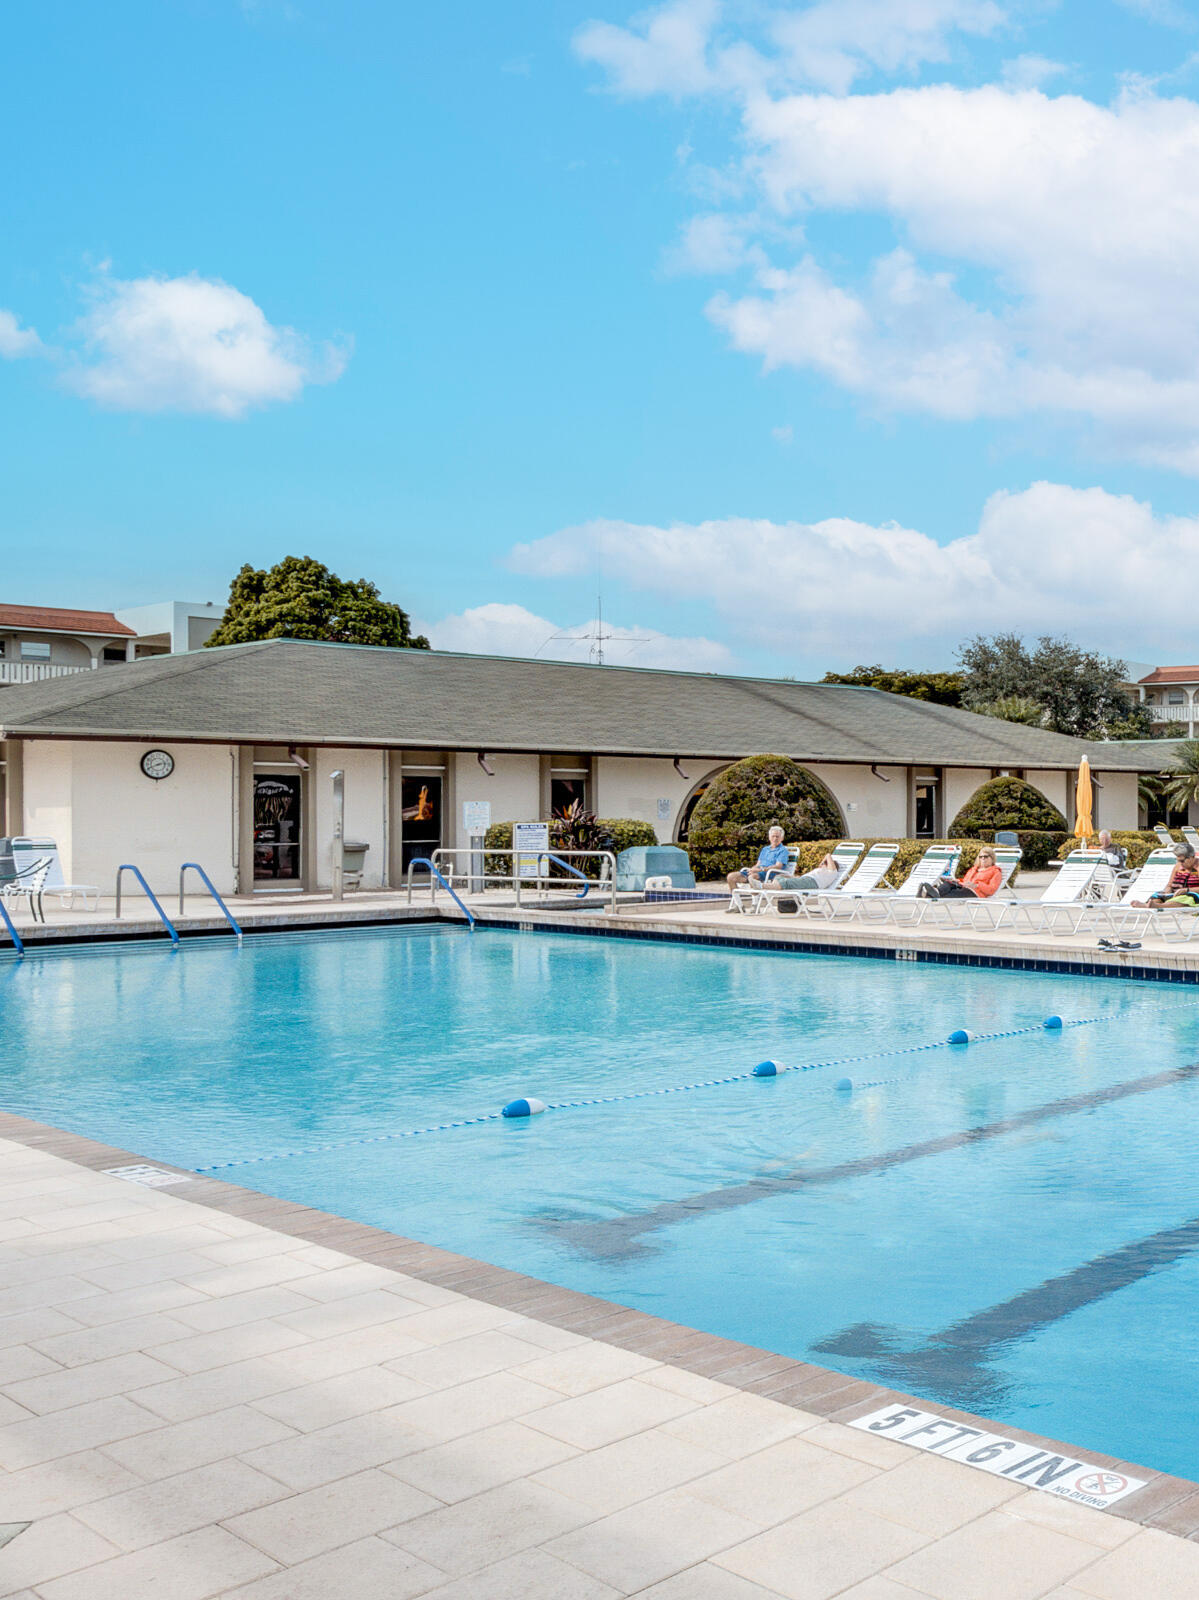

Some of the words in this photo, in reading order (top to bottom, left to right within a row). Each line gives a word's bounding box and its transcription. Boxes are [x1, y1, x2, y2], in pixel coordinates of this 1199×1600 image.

[868, 1408, 922, 1432] 5
[900, 1419, 987, 1450] FT
[965, 1440, 1016, 1463] 6
[1000, 1451, 1083, 1487] IN
[1051, 1485, 1071, 1495] NO
[1069, 1491, 1108, 1507] DIVING
